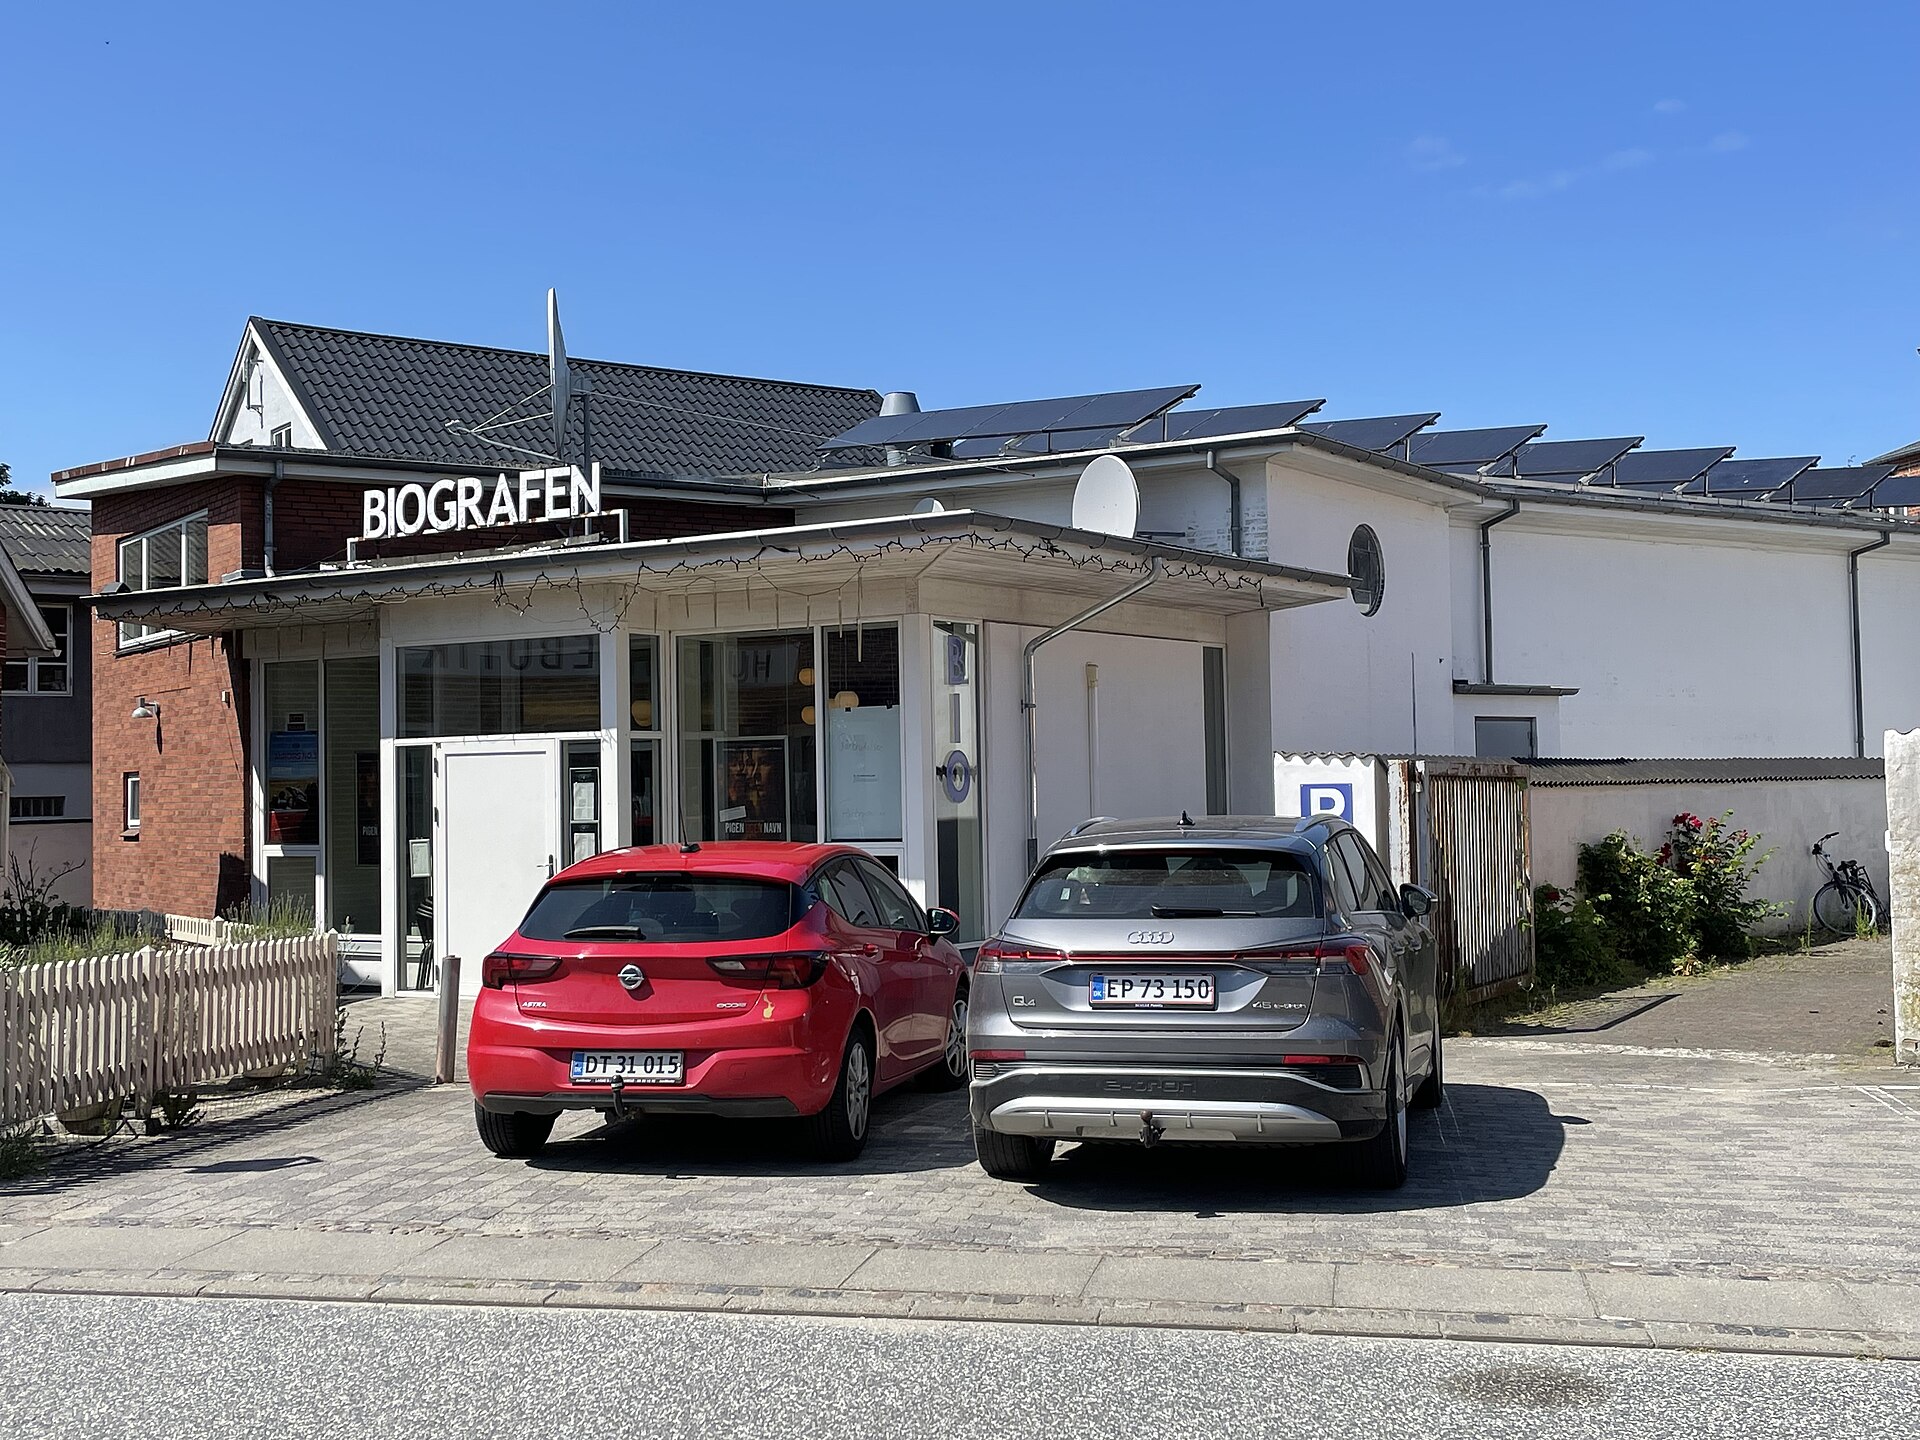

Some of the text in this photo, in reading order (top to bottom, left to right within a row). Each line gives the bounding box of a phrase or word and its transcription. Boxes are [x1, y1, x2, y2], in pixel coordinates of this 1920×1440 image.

[363, 461, 600, 540] BIOGRAFEN
[945, 635, 971, 803] BIO
[725, 822, 745, 834] PIGEN
[763, 822, 782, 834] NAVN
[1107, 979, 1134, 999] EP
[1140, 979, 1164, 999] 73
[1173, 979, 1210, 1000] 150
[1252, 1001, 1272, 1009] 45
[585, 1055, 611, 1074] DT
[615, 1055, 636, 1074] 31
[643, 1055, 680, 1074] 015
